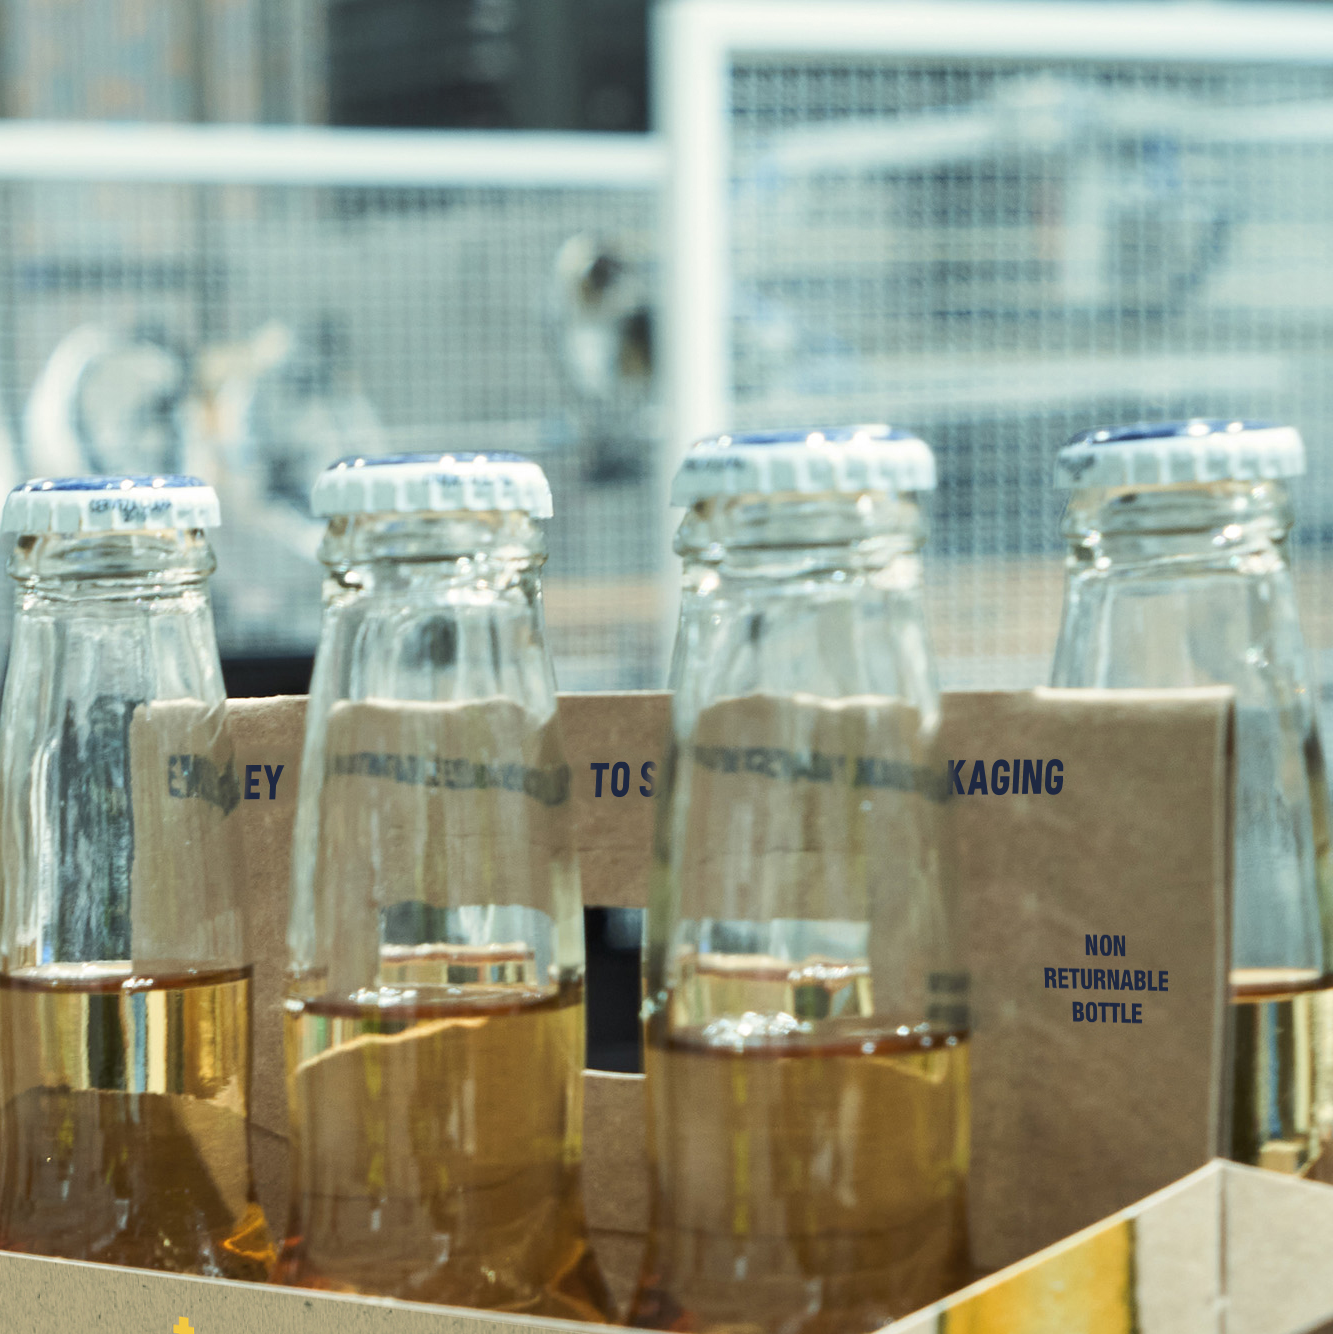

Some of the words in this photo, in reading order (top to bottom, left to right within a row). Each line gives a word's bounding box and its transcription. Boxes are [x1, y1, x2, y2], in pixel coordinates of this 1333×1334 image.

[590, 762, 631, 797] TO
[1084, 934, 1127, 958] NON
[1043, 966, 1169, 993] RETURNABLE
[1071, 1001, 1143, 1025] BOTTLE
